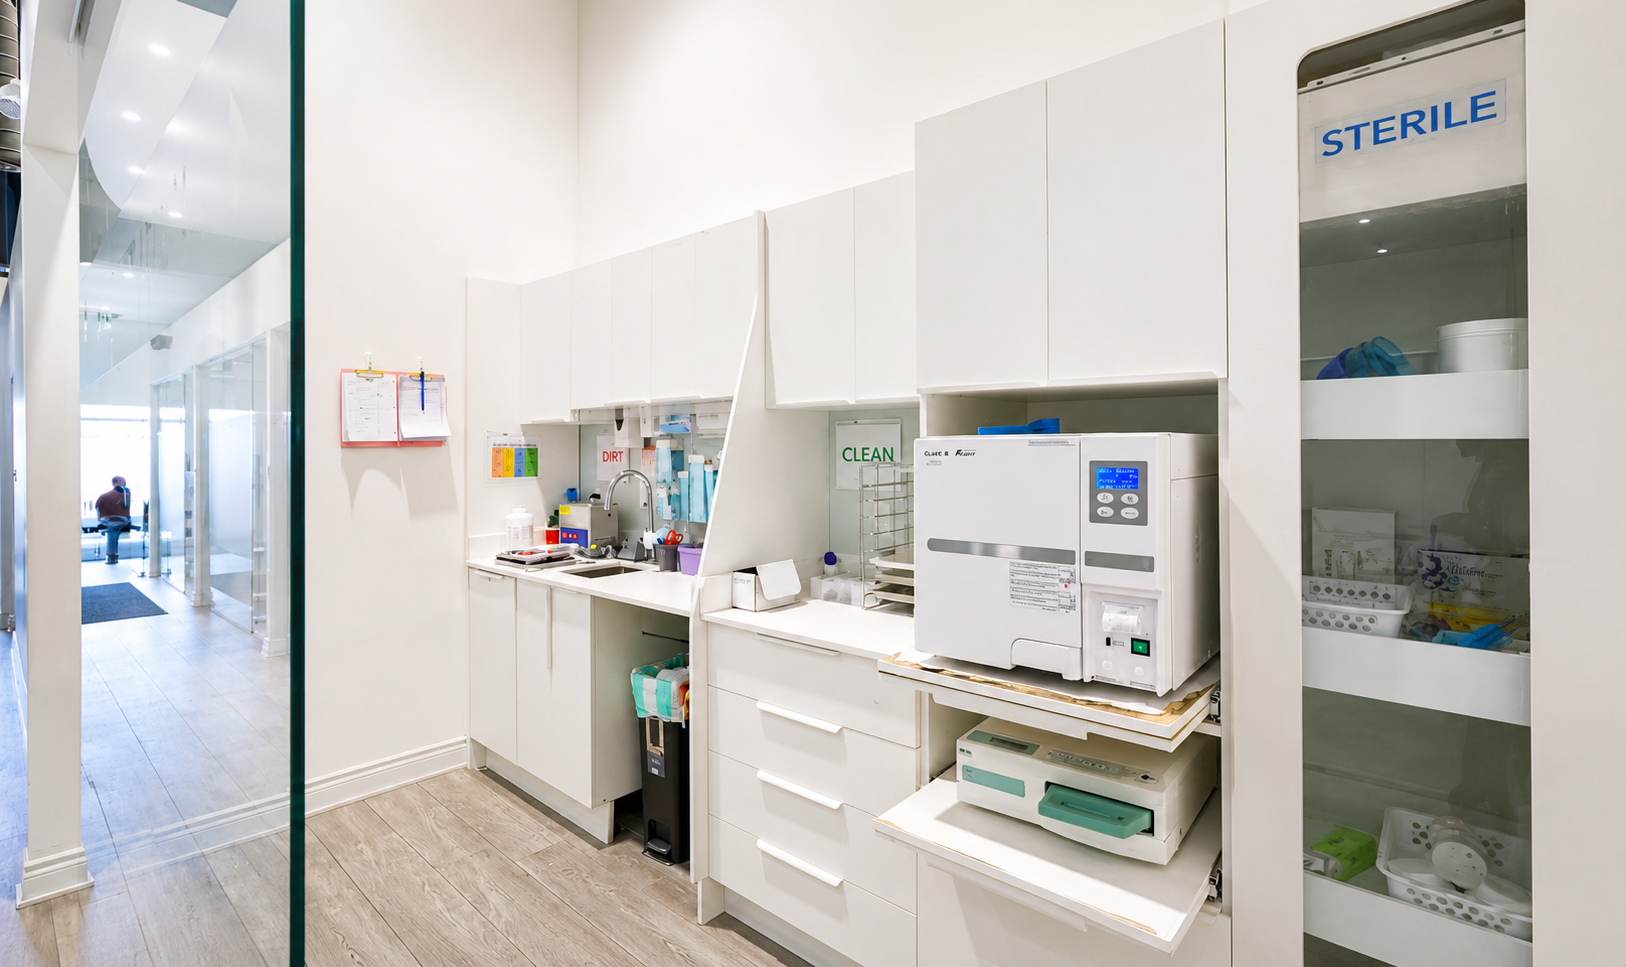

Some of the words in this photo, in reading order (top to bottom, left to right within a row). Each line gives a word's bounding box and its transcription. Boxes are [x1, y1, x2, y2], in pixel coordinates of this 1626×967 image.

[1322, 90, 1497, 157] STERILE
[602, 450, 624, 463] DIRT
[842, 447, 894, 462] CLEAN
